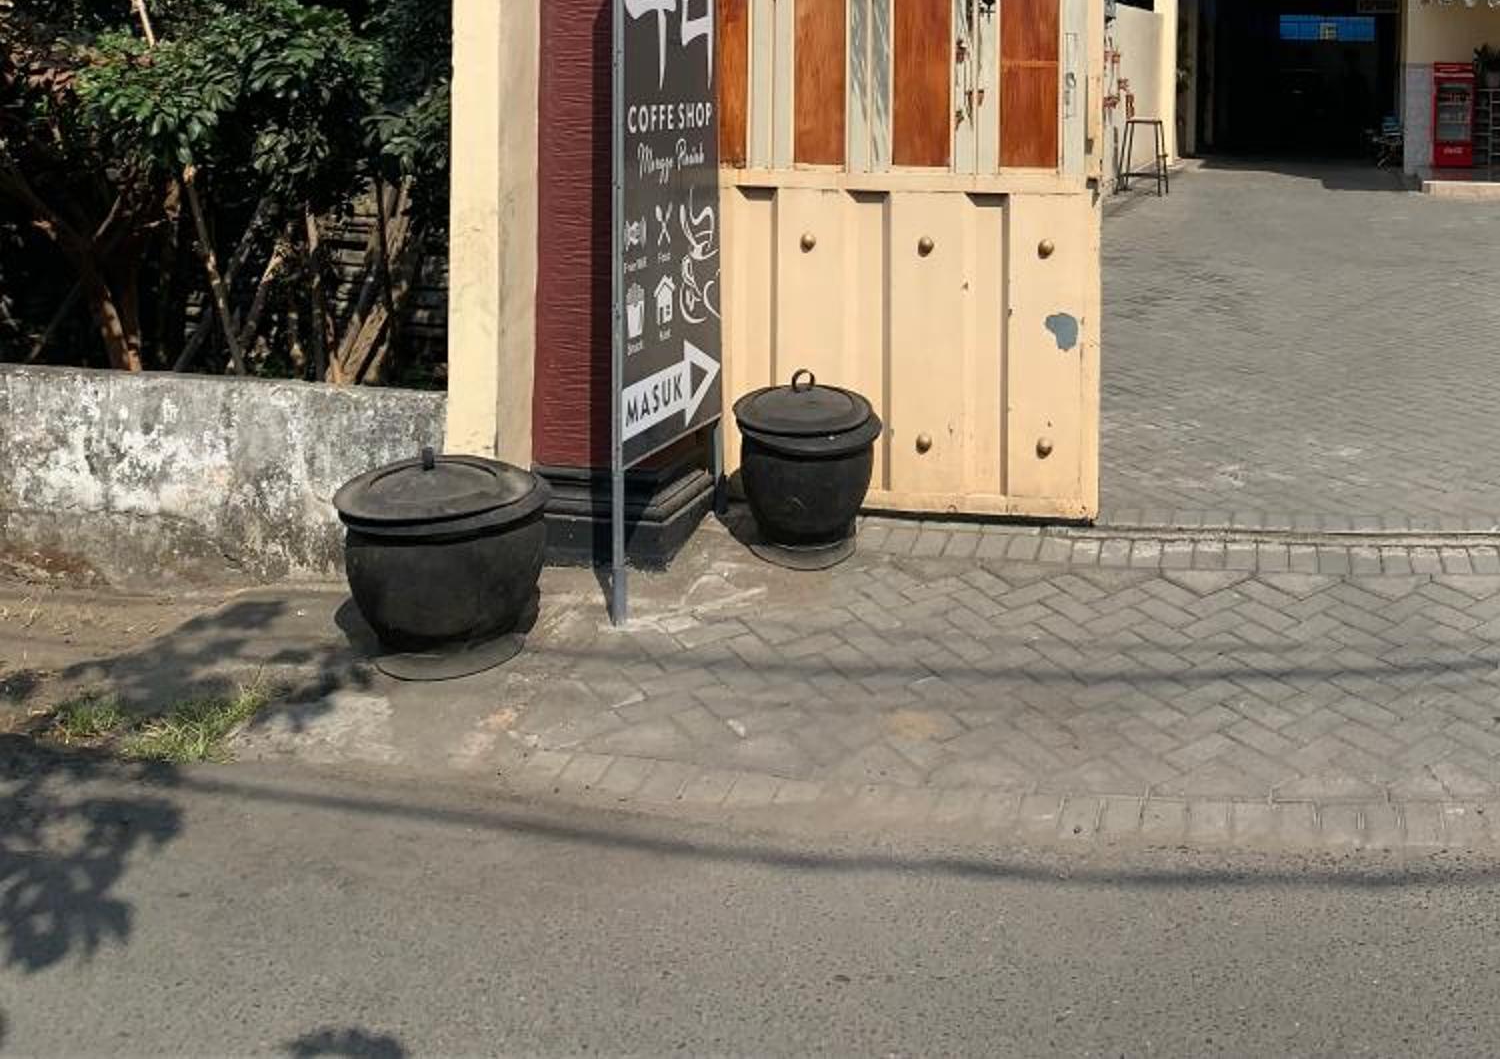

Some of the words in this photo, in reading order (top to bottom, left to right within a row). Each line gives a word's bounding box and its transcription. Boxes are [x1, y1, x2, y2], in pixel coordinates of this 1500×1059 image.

[627, 104, 674, 134] COFFE
[678, 102, 713, 130] SHOP
[625, 371, 683, 428] MASUK
